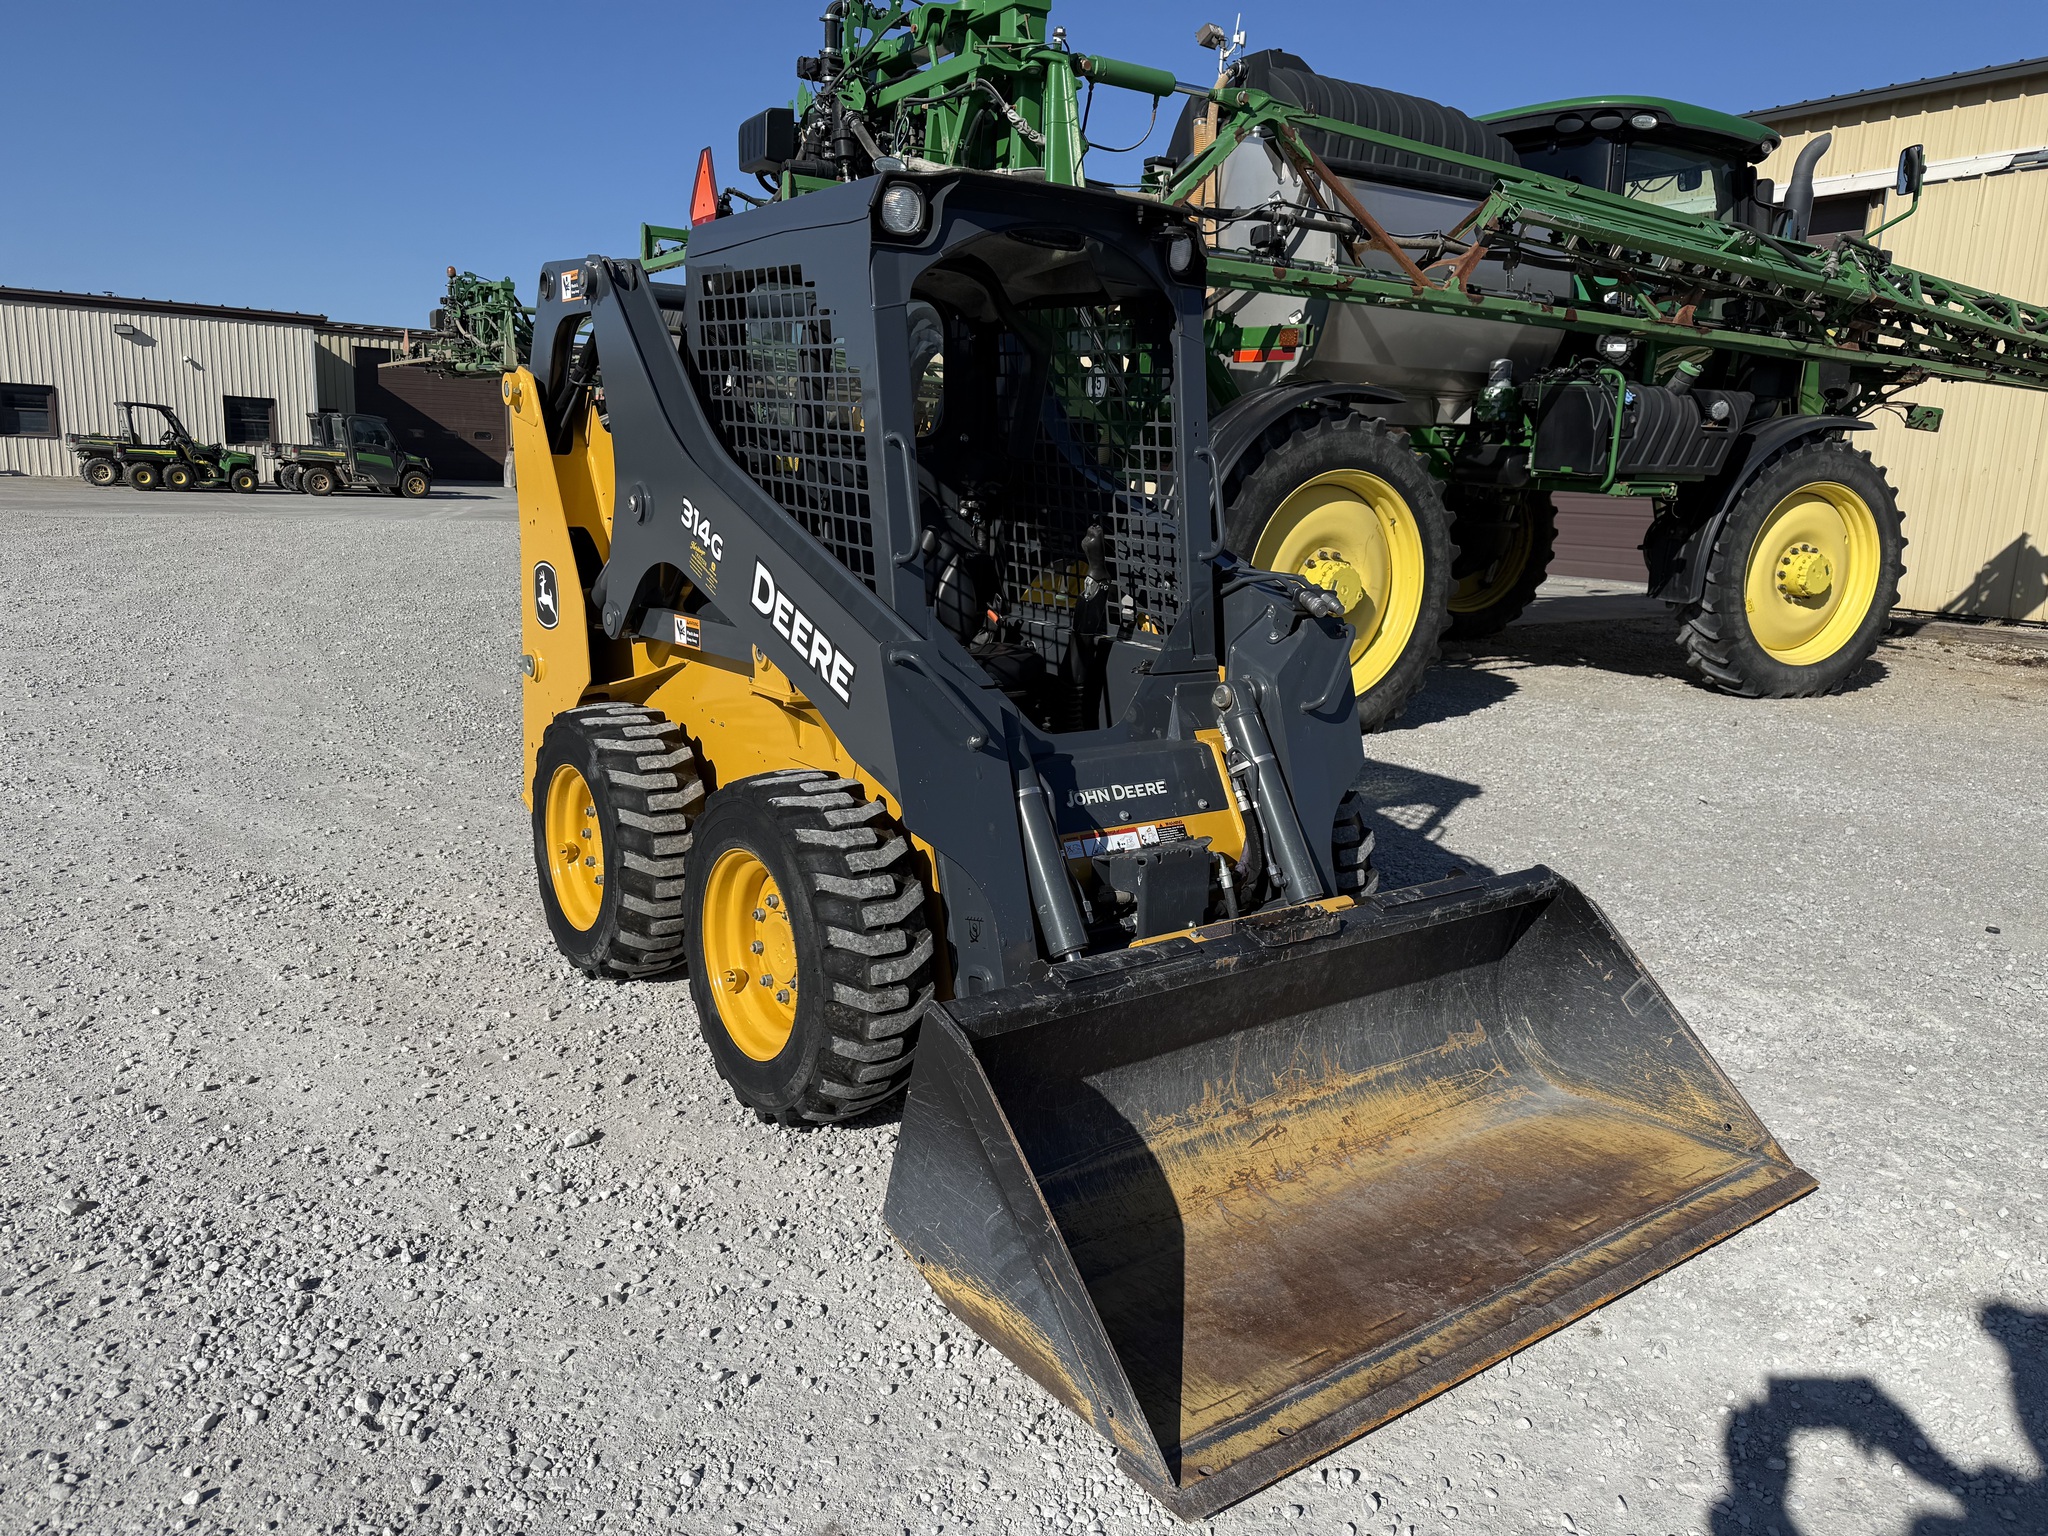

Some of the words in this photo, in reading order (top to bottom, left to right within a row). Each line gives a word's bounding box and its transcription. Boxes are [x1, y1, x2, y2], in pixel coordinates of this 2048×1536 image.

[680, 497, 723, 562] 314G
[751, 561, 855, 703] DEERE
[1066, 788, 1111, 808] JOHN
[1111, 780, 1168, 801] DEERE
